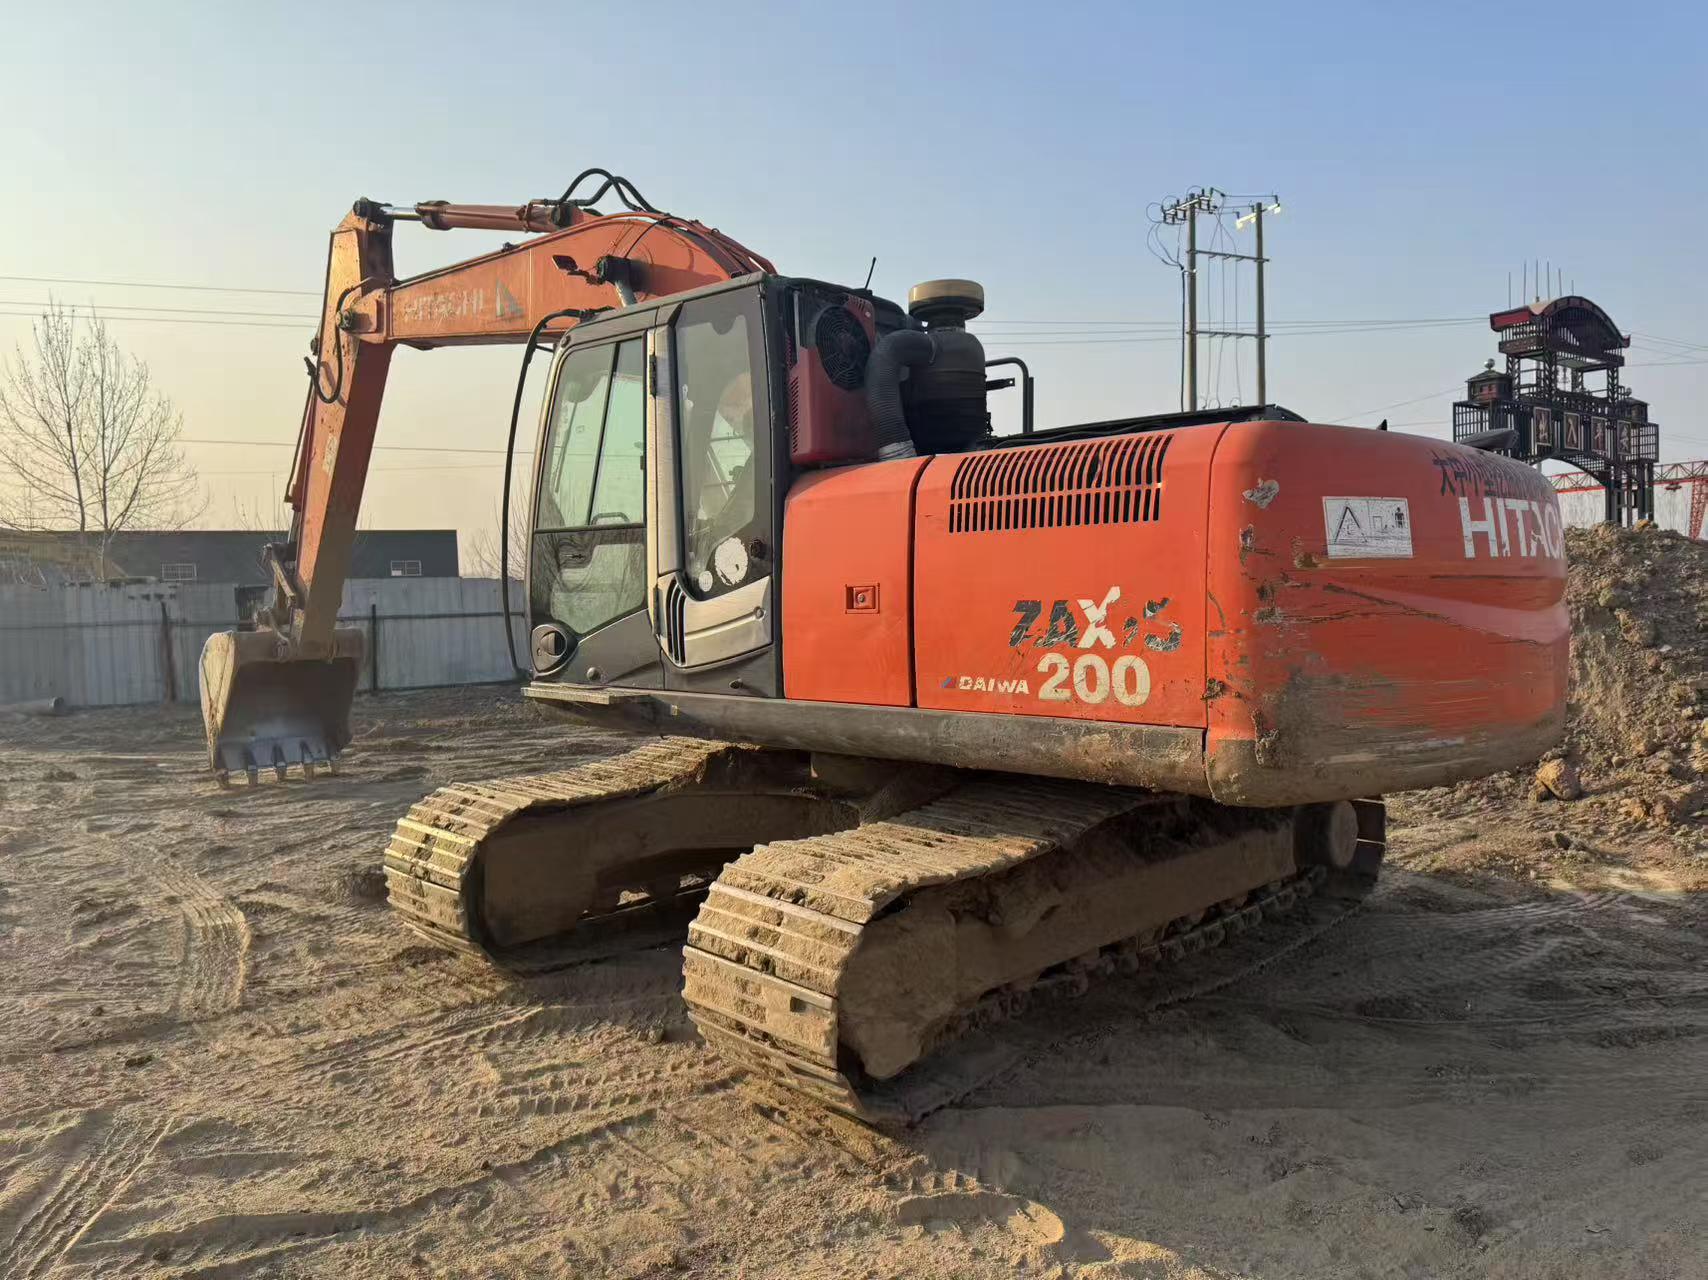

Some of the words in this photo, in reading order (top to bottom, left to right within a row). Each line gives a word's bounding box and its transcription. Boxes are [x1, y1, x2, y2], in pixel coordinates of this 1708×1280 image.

[1458, 496, 1564, 559] HITAC
[958, 675, 1030, 695] DAIWA
[1037, 652, 1151, 706] 200
